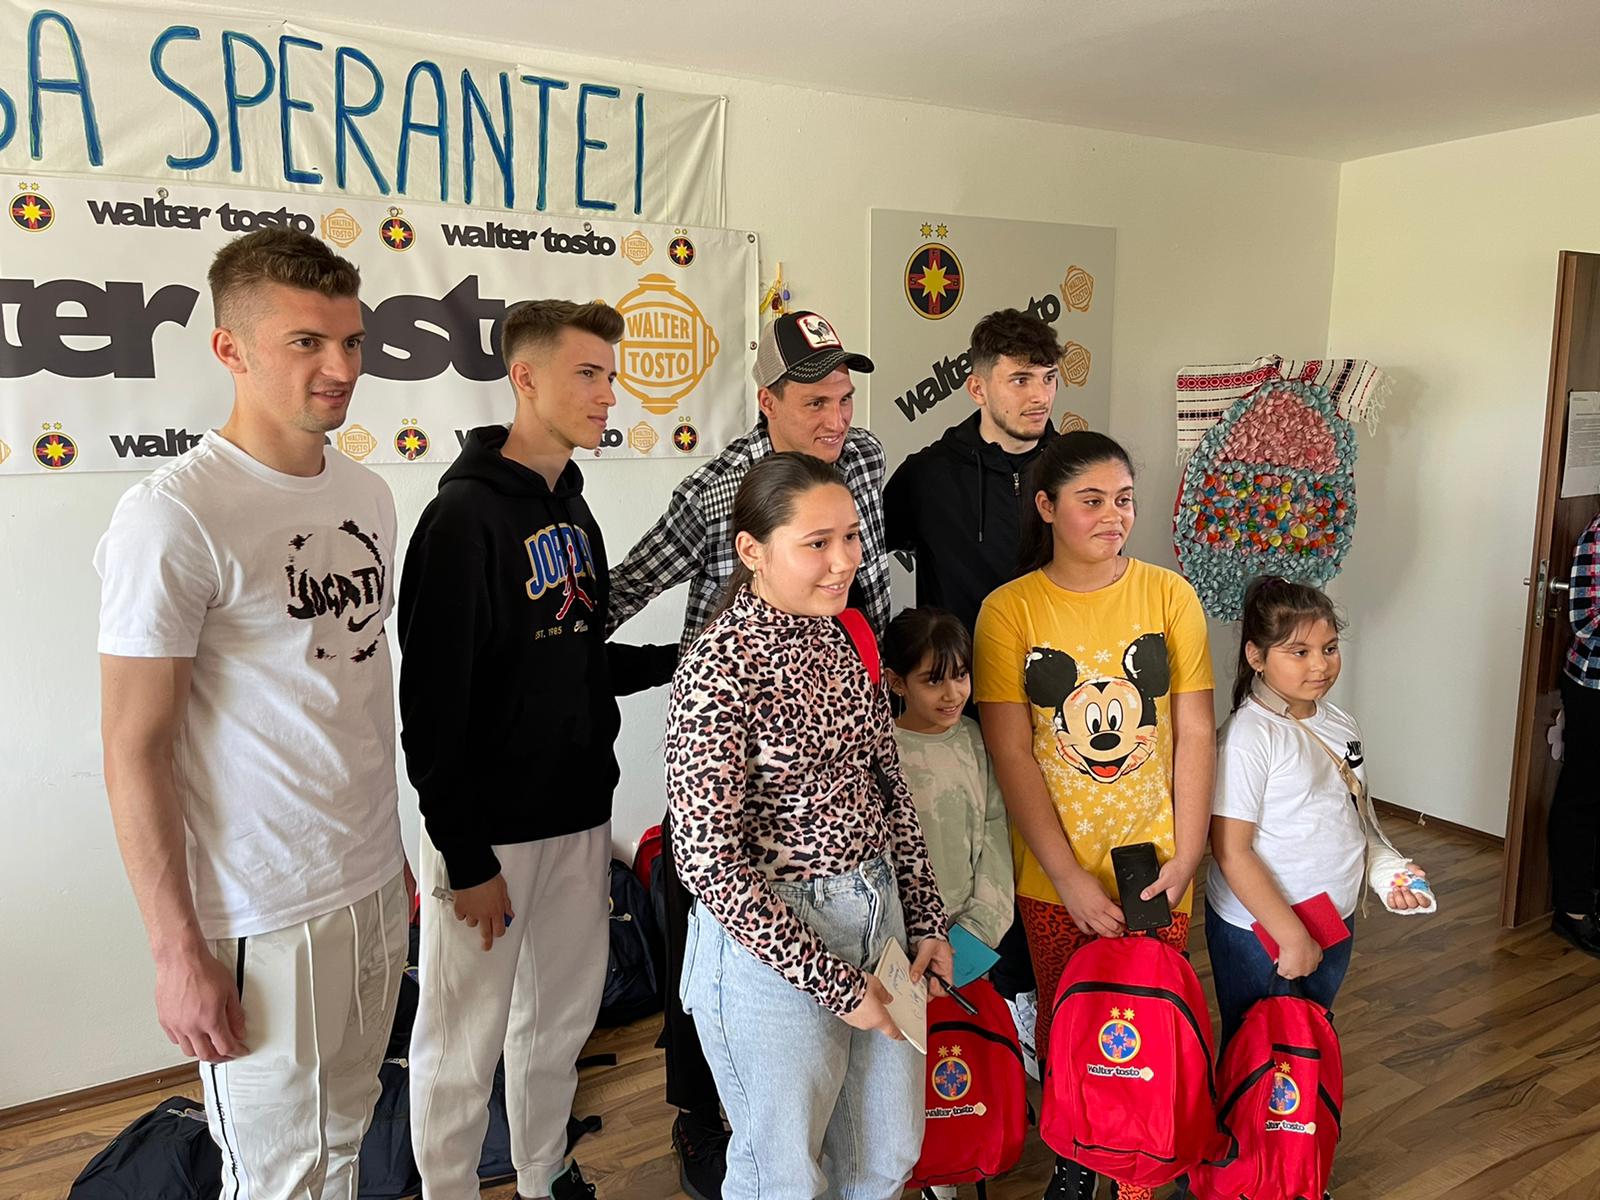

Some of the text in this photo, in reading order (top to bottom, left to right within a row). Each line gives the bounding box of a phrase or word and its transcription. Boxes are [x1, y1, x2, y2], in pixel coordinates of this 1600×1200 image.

[150, 25, 646, 214] SPERANTEI
[87, 197, 315, 236] walter tosto
[441, 221, 617, 257] walter tosto
[625, 311, 689, 339] WALTER
[628, 351, 689, 379] TOSTO
[894, 347, 974, 423] walte
[109, 427, 204, 458] walt
[524, 523, 597, 600] JORDA
[1115, 1067, 1140, 1076] tosto
